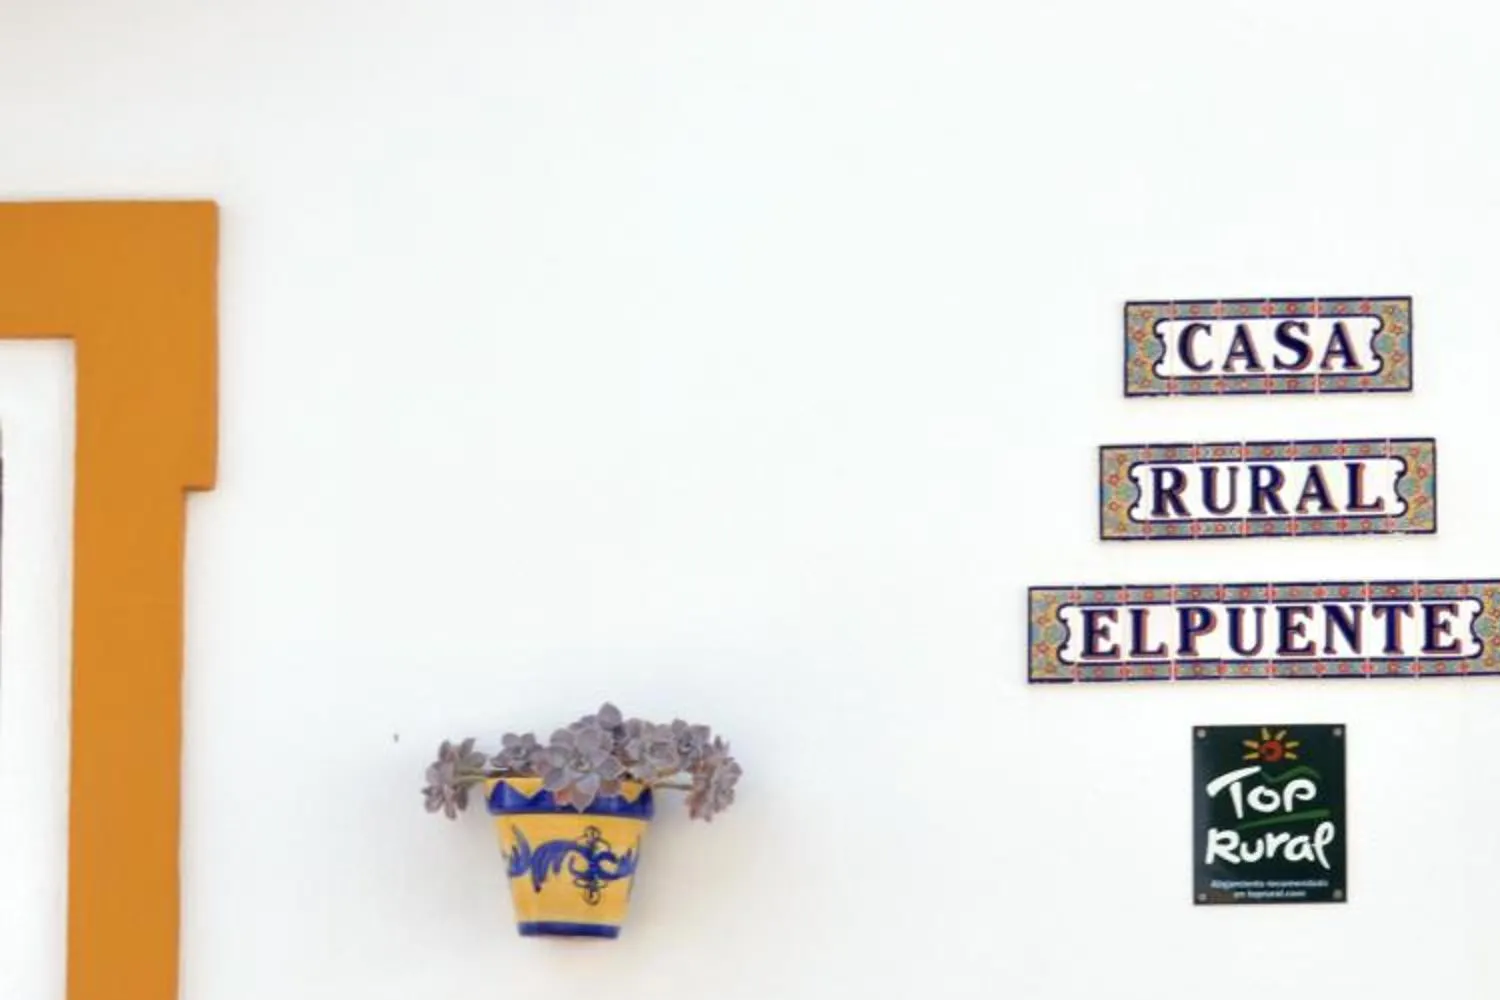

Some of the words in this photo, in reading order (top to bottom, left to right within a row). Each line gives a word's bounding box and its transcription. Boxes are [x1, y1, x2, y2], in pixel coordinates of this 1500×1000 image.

[1178, 321, 1363, 372] CASA
[1150, 463, 1385, 517] RURAL
[1205, 821, 1335, 870] Rural
